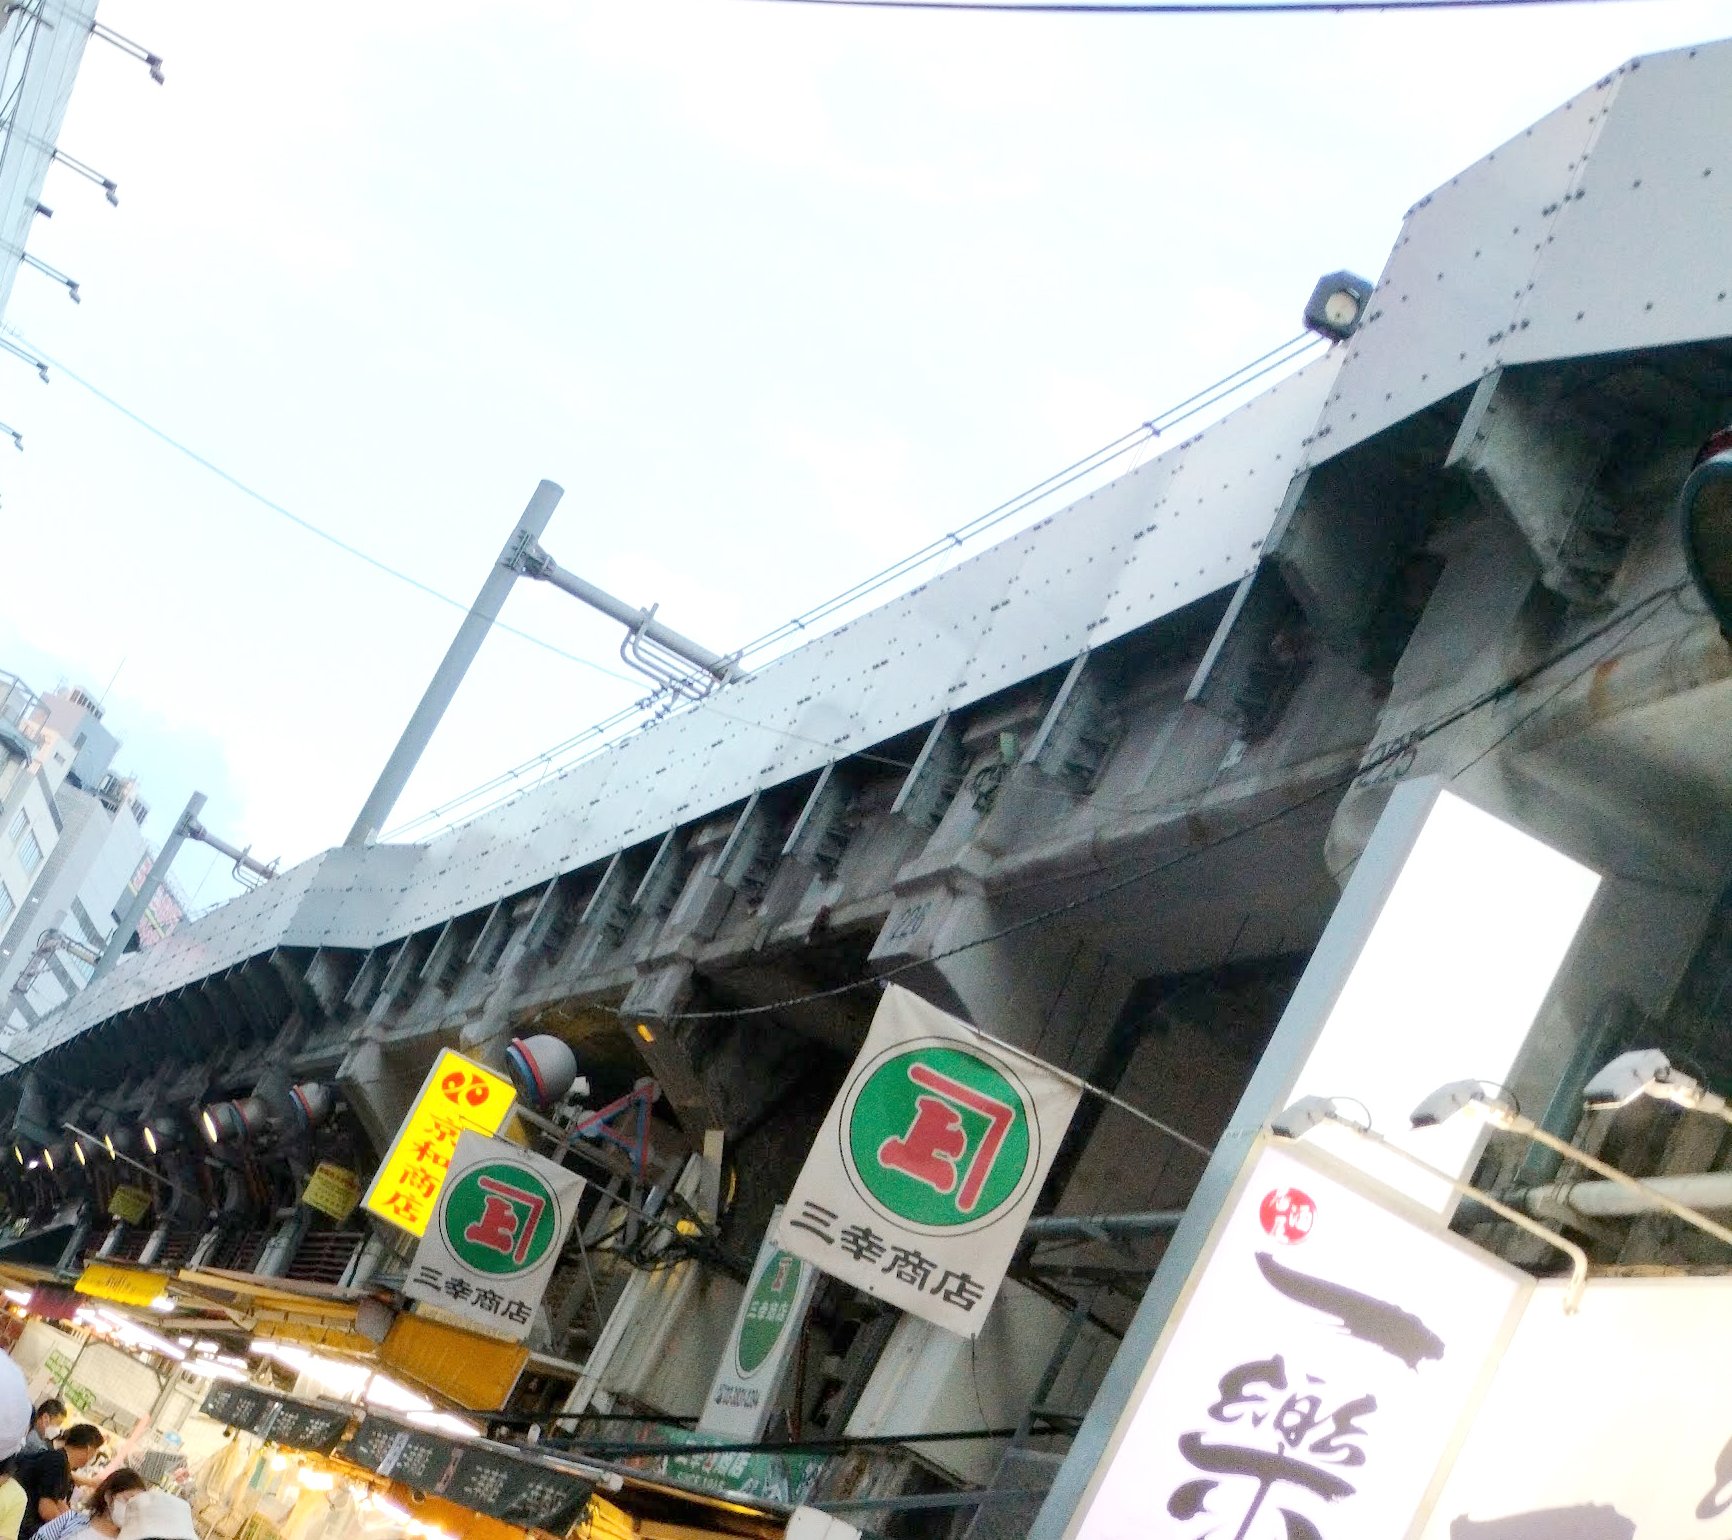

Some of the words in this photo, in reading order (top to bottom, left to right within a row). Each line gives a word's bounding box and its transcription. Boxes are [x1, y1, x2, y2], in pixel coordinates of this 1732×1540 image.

[413, 1265, 534, 1327] 三幸商店
[789, 1199, 986, 1312] 三幸商店
